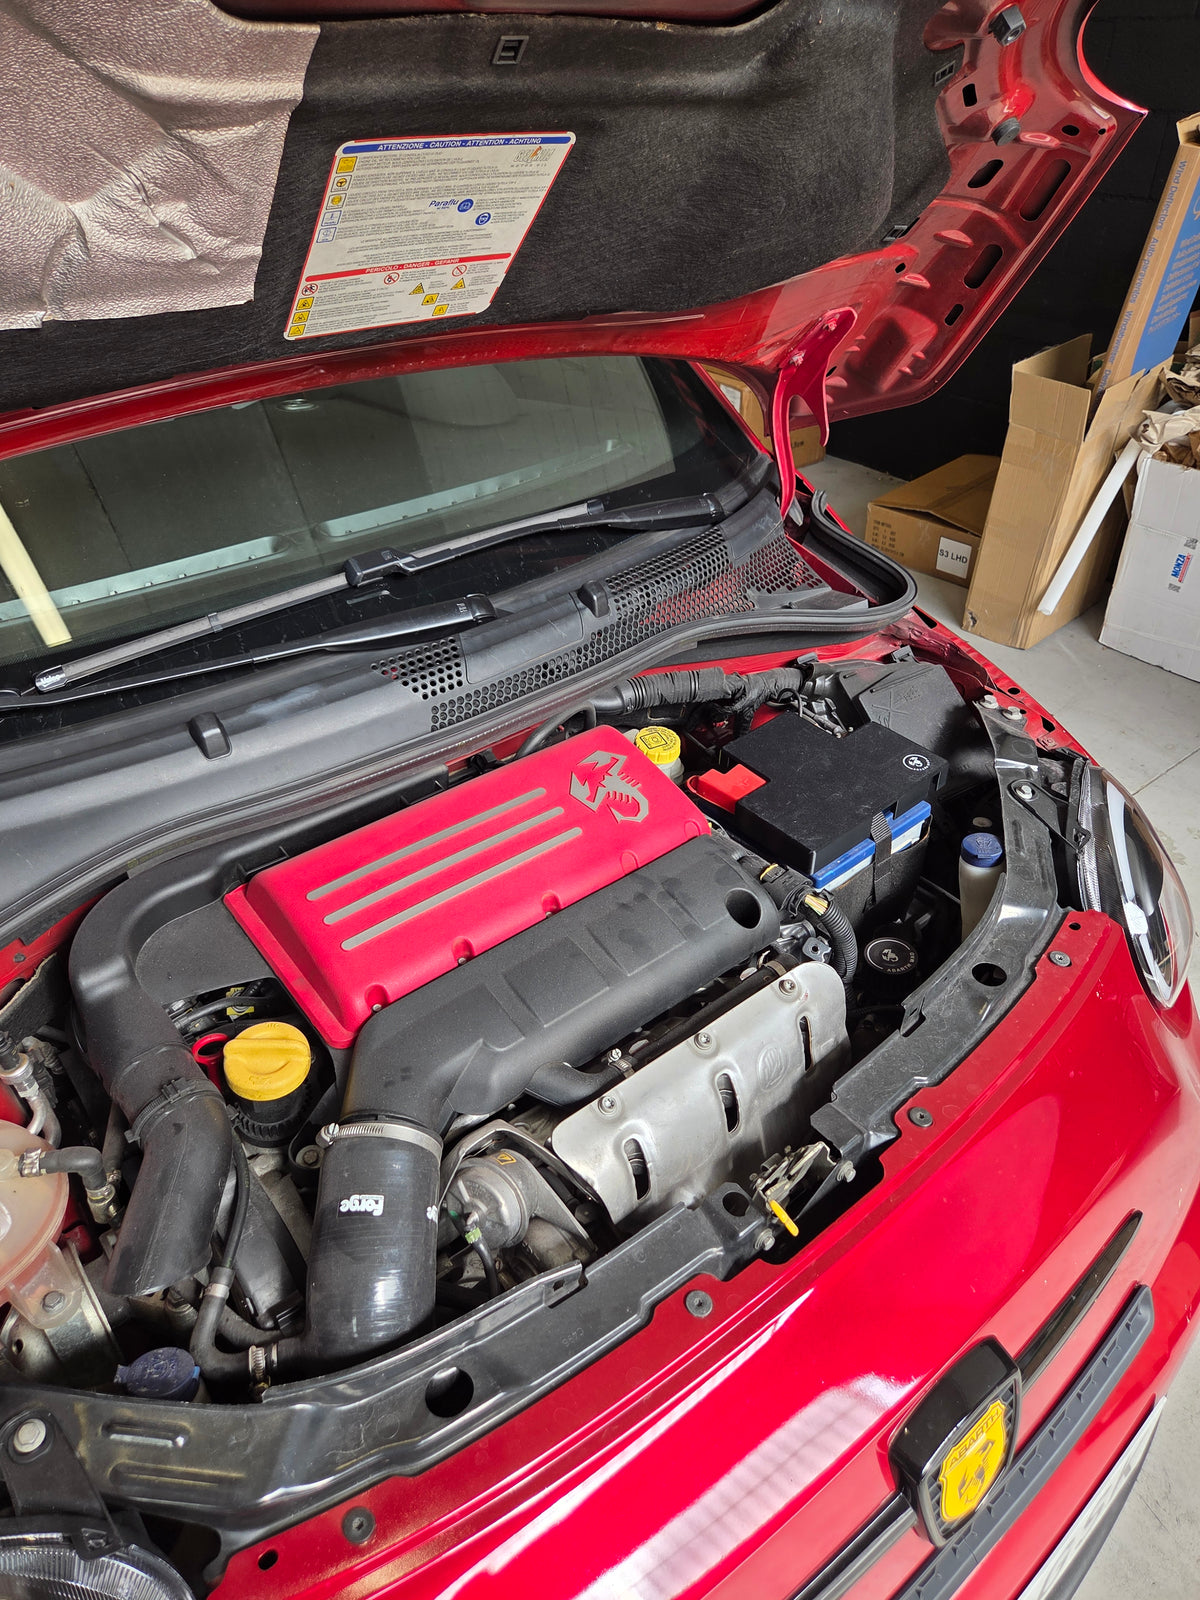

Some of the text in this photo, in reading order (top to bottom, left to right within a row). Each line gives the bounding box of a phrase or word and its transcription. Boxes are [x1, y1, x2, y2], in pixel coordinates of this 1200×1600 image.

[377, 142, 424, 151] ATTENZIONE
[429, 140, 461, 149] CAUTION
[466, 138, 504, 147] ATTENTION
[509, 137, 542, 145] ACHTUNG
[1172, 160, 1187, 184] Wind
[428, 198, 460, 208] Paraflu
[1156, 186, 1179, 231] Deflectors
[365, 264, 399, 274] PERICOLO
[403, 261, 430, 270] DANGER
[434, 258, 460, 267] GEFAHR
[938, 548, 968, 564] S3 LHD
[1171, 553, 1187, 579] MONZA
[886, 963, 912, 973] ABARTH
[949, 1408, 1000, 1468] ABARTH
